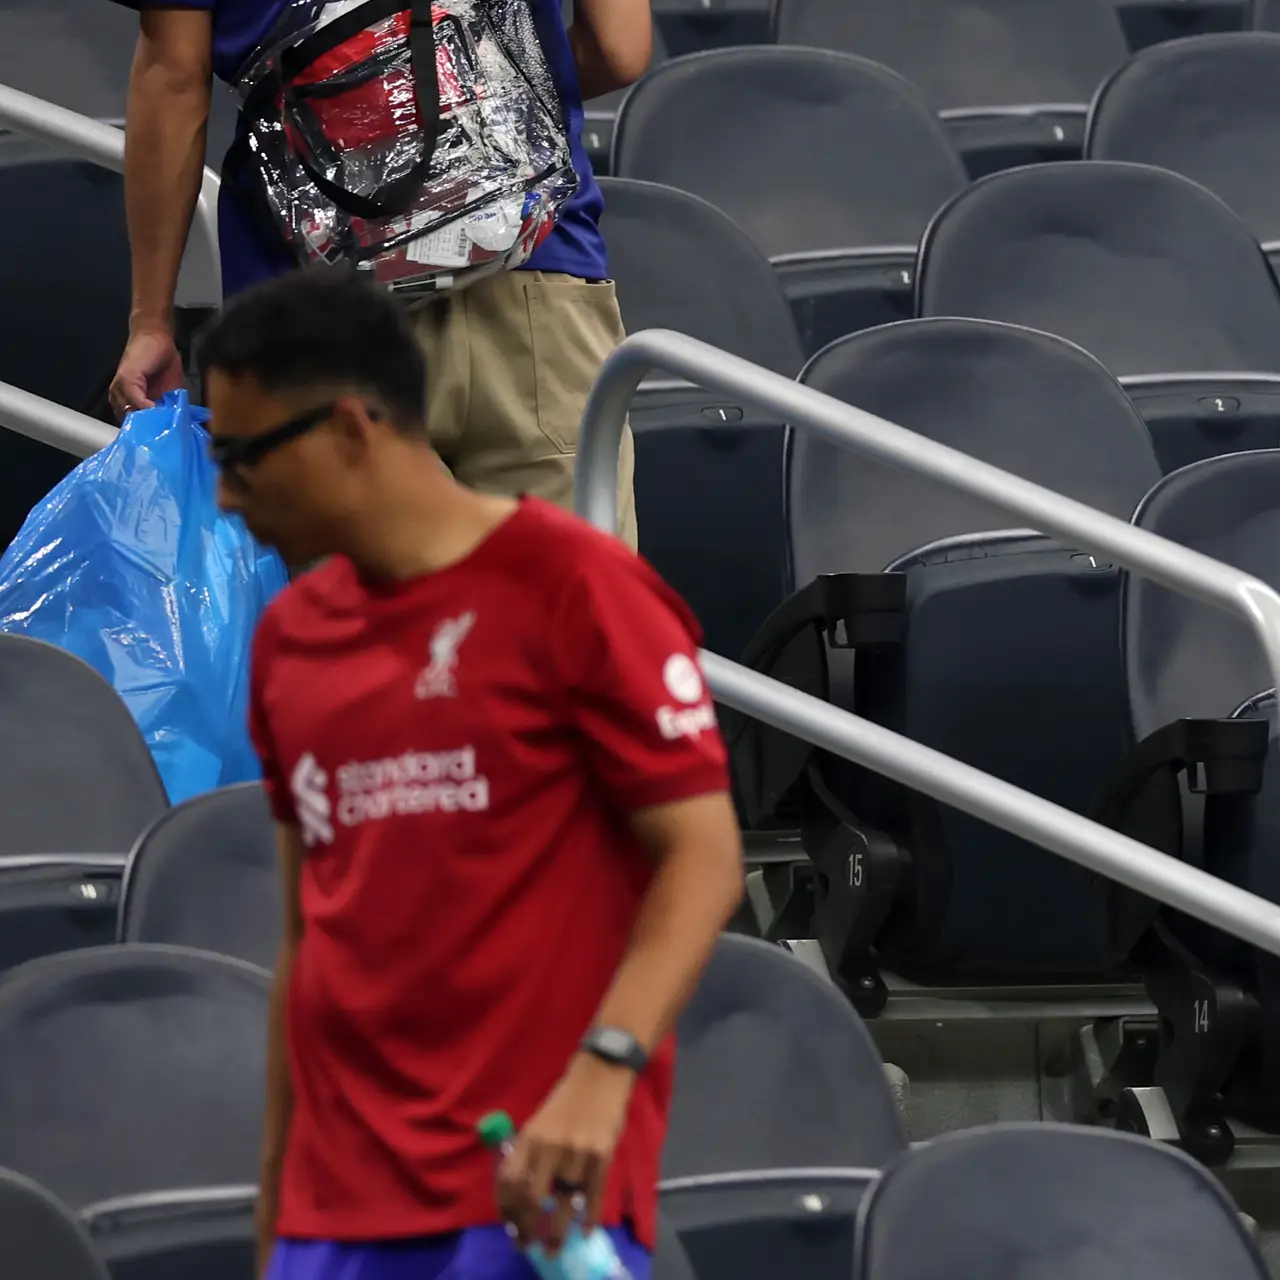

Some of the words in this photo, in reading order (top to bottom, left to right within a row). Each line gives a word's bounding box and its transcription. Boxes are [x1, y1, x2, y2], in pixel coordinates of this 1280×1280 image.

[1215, 398, 1225, 412] 2
[336, 745, 476, 794] standard
[337, 775, 489, 826] chartered
[848, 853, 863, 887] 15
[1193, 999, 1209, 1033] 14
